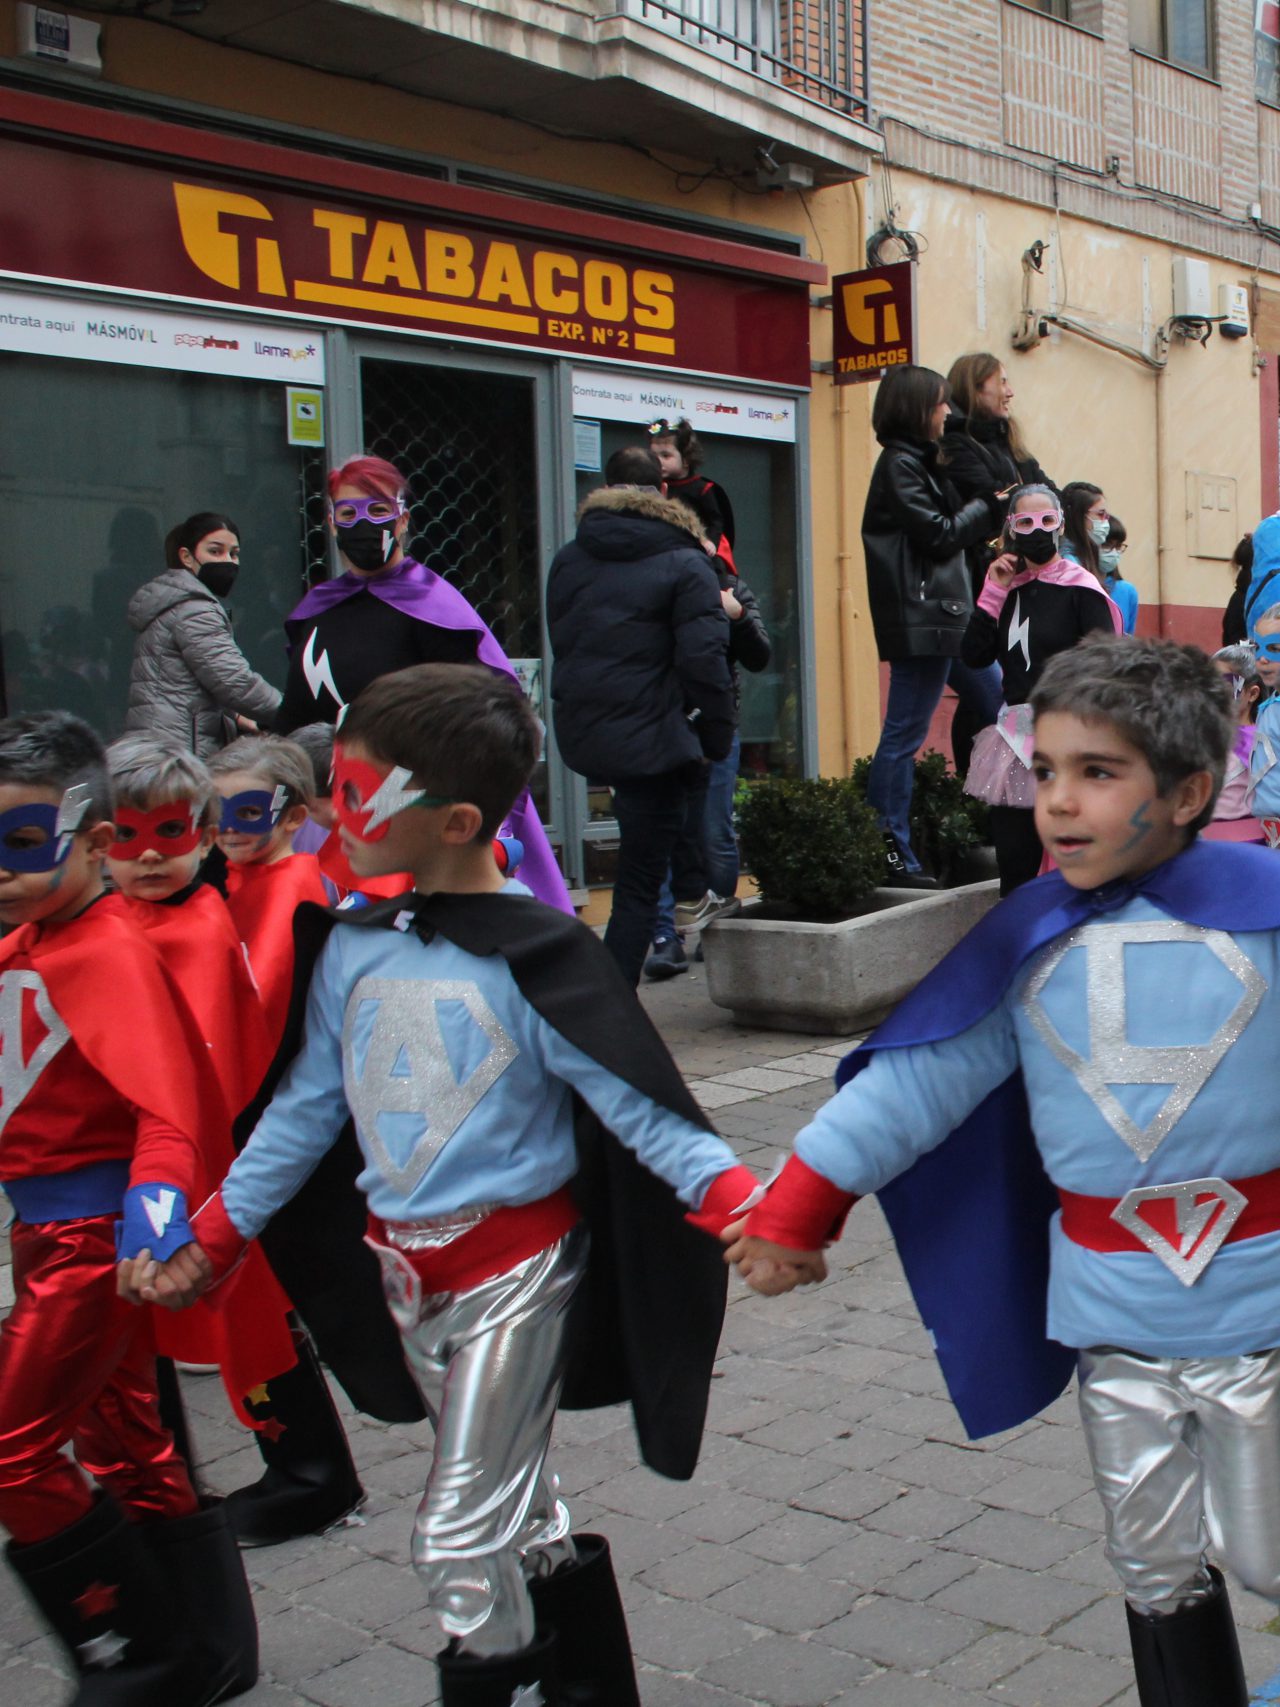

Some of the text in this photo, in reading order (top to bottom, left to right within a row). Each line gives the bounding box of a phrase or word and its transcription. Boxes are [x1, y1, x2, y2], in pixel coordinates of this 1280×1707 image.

[312, 208, 675, 331] TABACOS
[87, 320, 158, 344] MÁSMÓVIL
[174, 333, 240, 351] pepephone
[547, 319, 586, 342] EXP.
[617, 330, 630, 348] 2
[838, 347, 908, 373] TABACOS
[572, 385, 612, 399] Contrata
